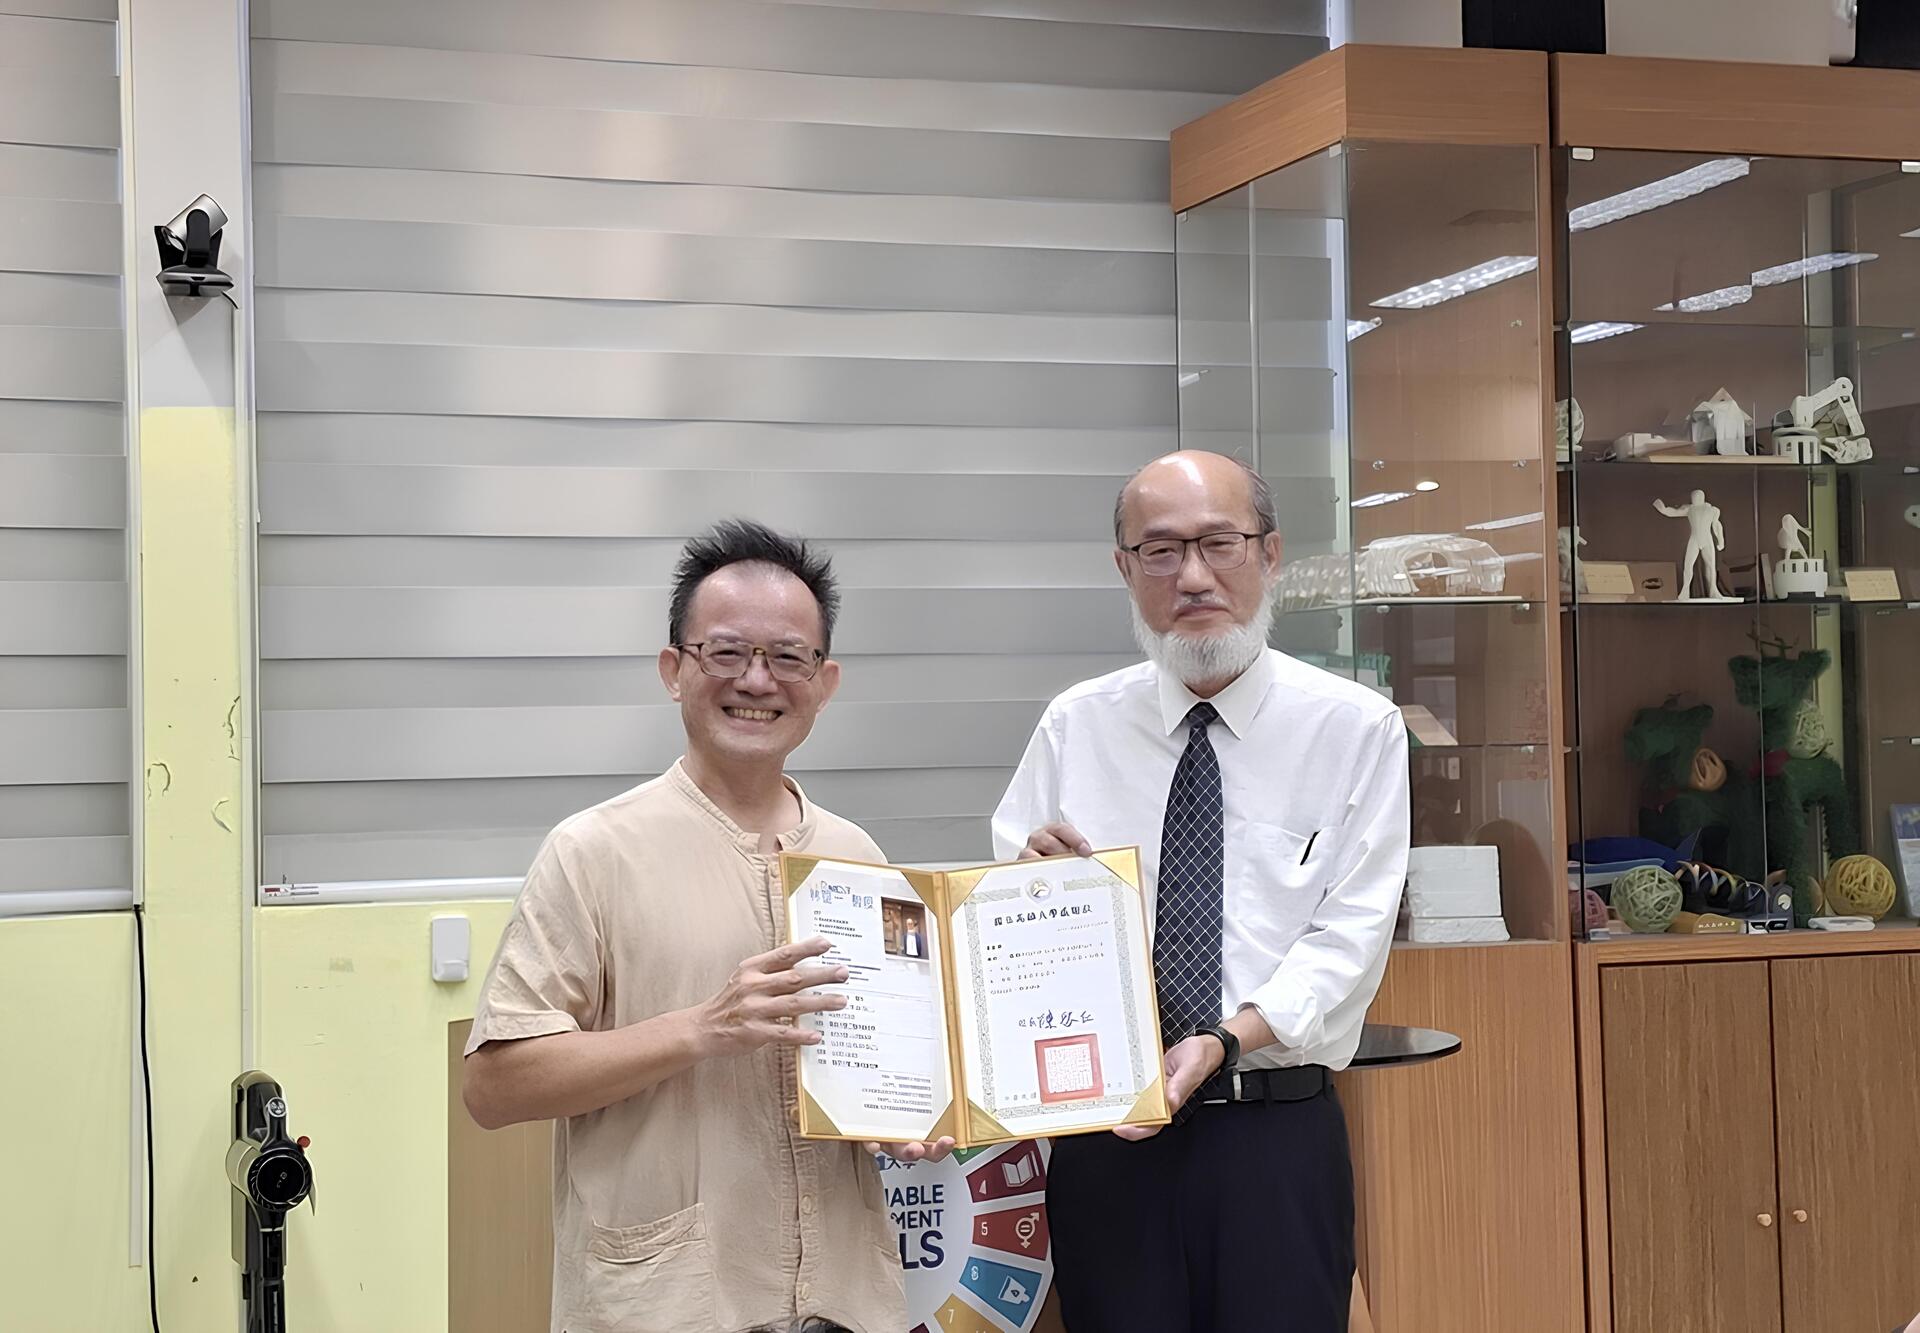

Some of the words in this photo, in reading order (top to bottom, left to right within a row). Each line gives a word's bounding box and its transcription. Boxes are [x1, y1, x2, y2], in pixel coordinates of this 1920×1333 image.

[885, 1184, 944, 1207] ABLE
[899, 1230, 945, 1269] LS
[948, 1309, 955, 1324] 7
